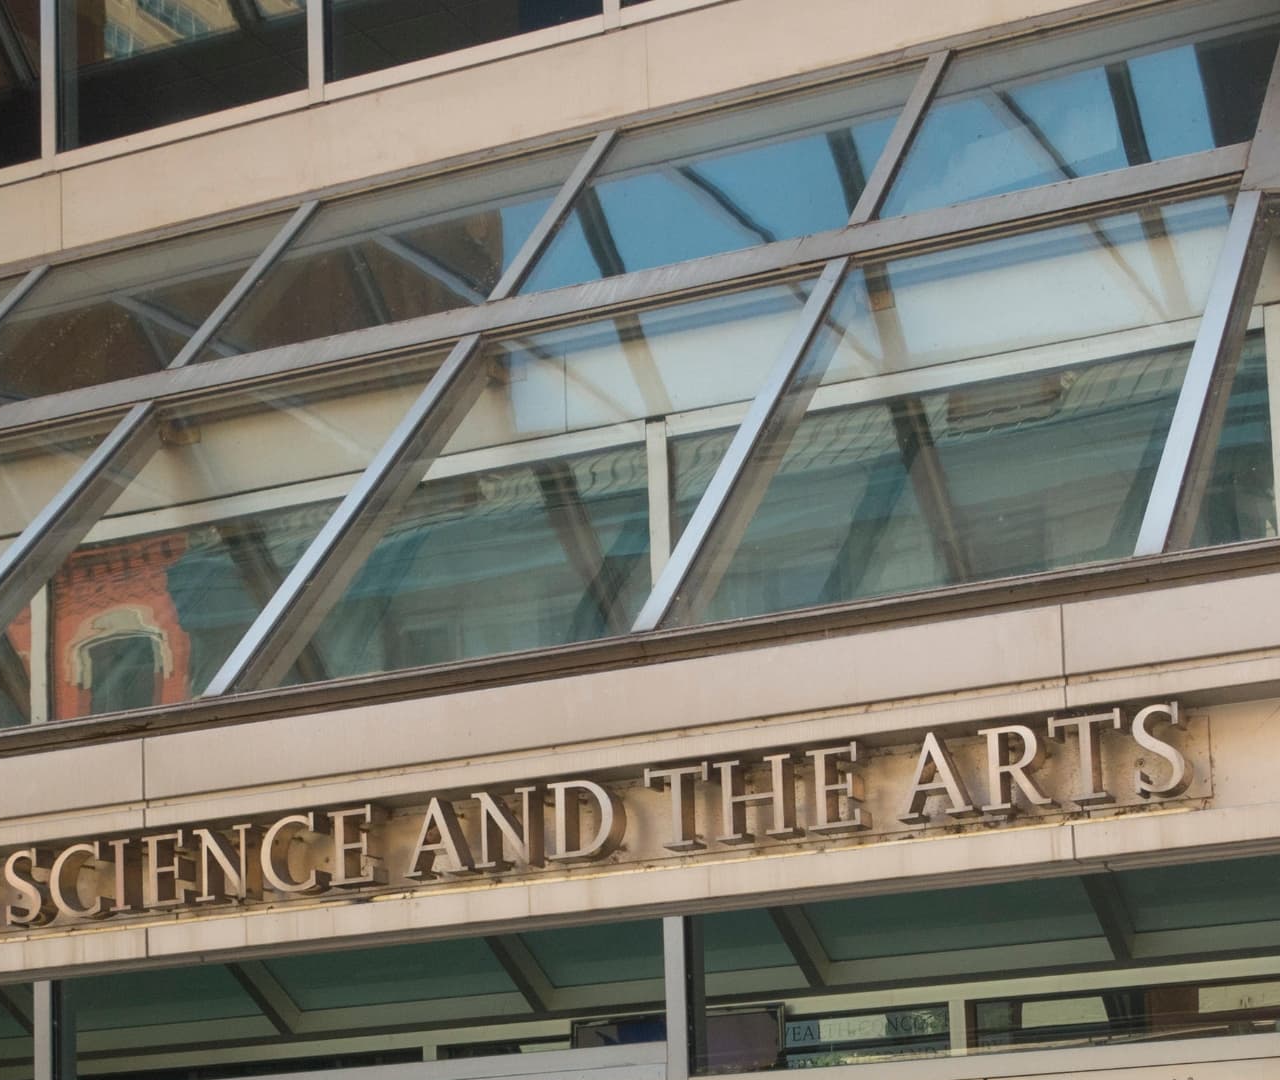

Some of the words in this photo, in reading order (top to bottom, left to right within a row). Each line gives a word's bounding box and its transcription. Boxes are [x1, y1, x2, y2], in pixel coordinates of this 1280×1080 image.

[4, 803, 380, 928] SCIENCE
[404, 780, 616, 880] AND
[644, 740, 868, 851] THE
[899, 701, 1188, 824] ARTS
